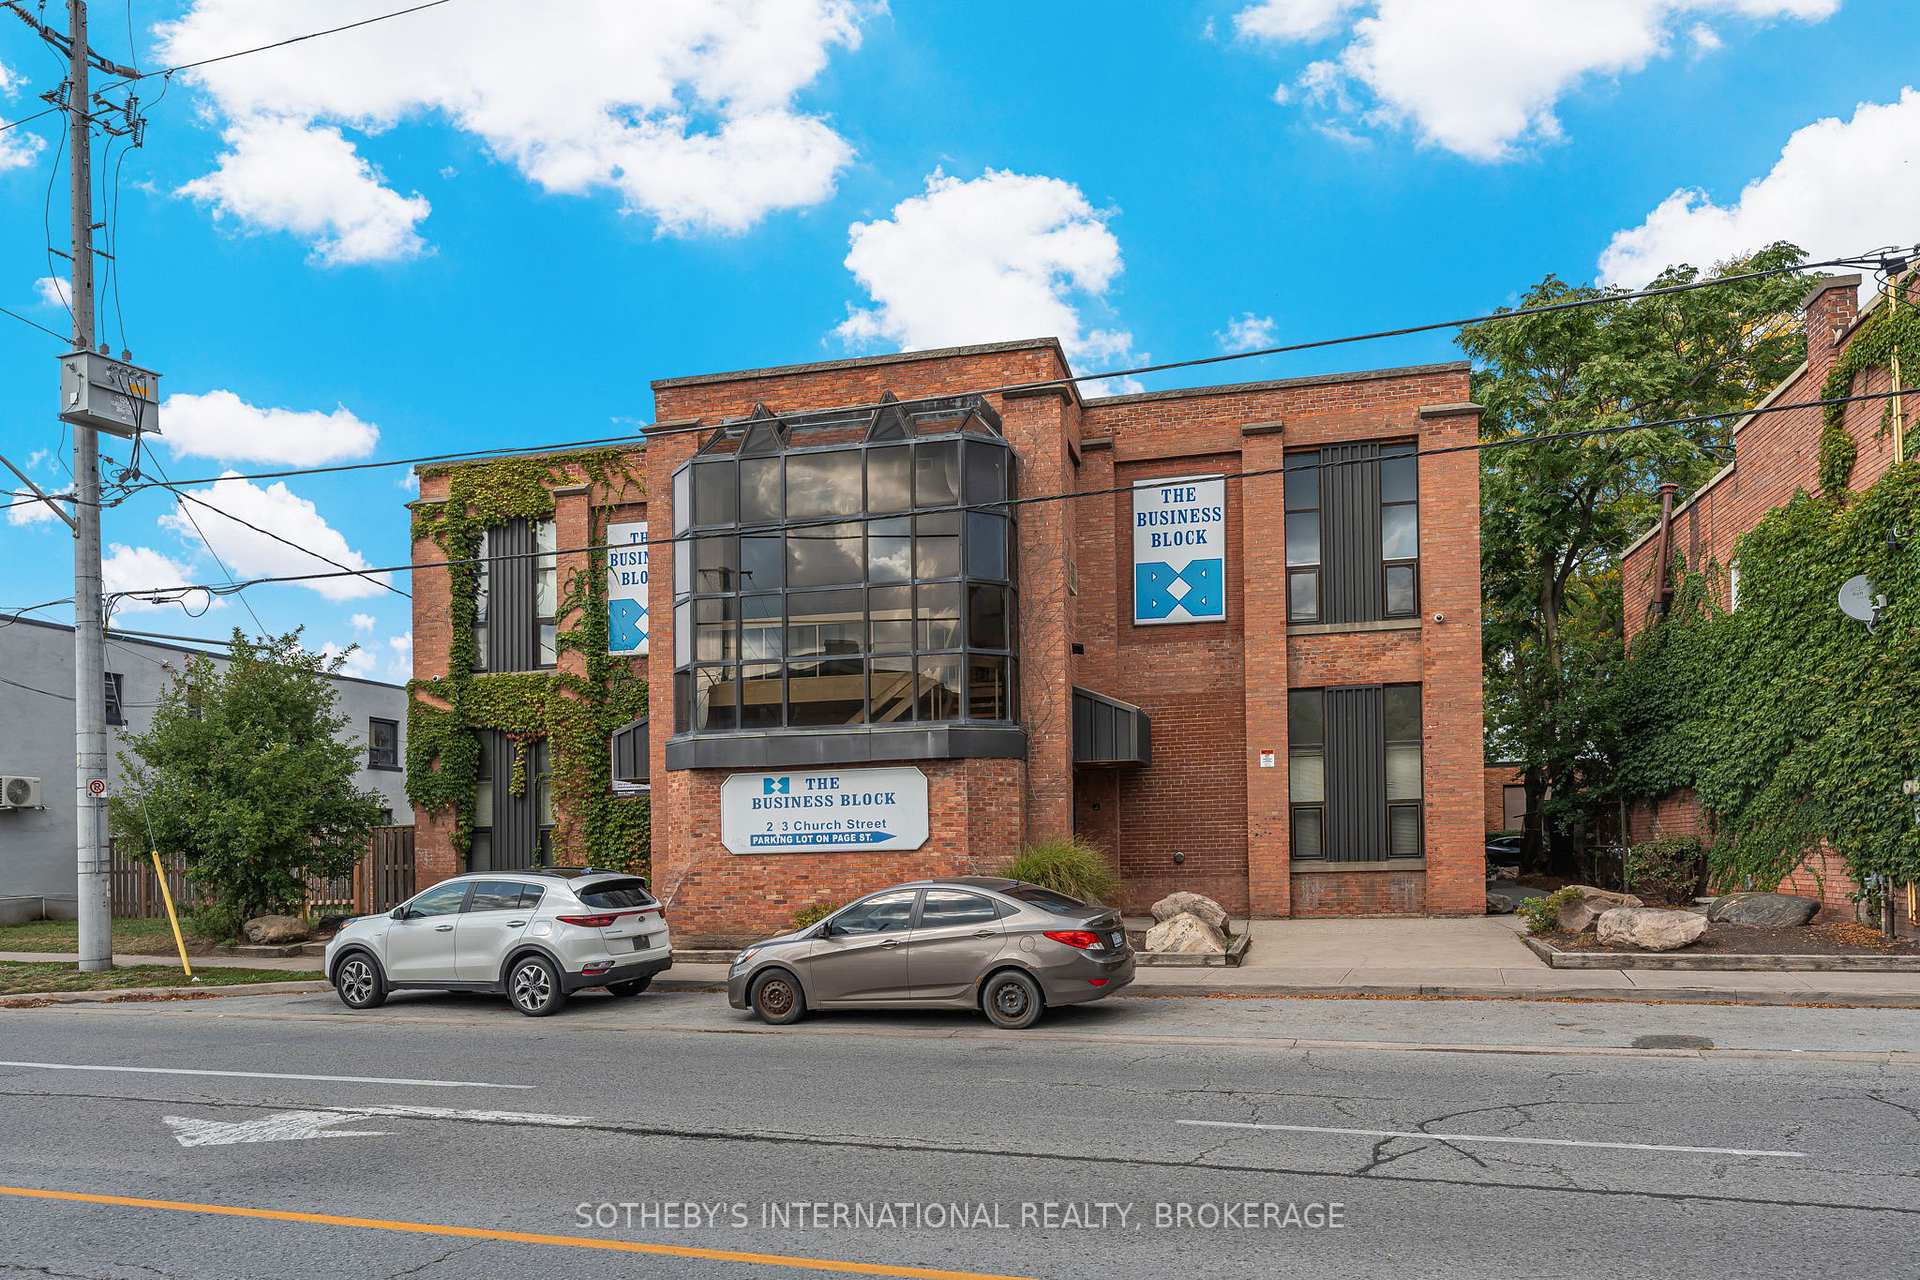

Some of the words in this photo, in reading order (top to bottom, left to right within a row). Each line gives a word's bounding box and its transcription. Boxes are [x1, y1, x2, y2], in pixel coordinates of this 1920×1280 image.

[1161, 487, 1196, 504] THE
[1137, 506, 1222, 527] BUSINESS
[630, 532, 648, 545] TH
[1151, 529, 1208, 548] BLOCK
[610, 551, 648, 567] BUSI
[621, 570, 648, 586] BLO
[805, 777, 840, 790] THE
[752, 795, 834, 810] BUSINESS
[840, 792, 896, 806] BLOCK
[793, 820, 841, 831] Church
[846, 819, 887, 829] Street
[752, 835, 793, 845] PARKING
[795, 834, 815, 844] LOT
[816, 834, 829, 843] ON
[832, 833, 856, 843] PAGE
[859, 832, 873, 842] ST.
